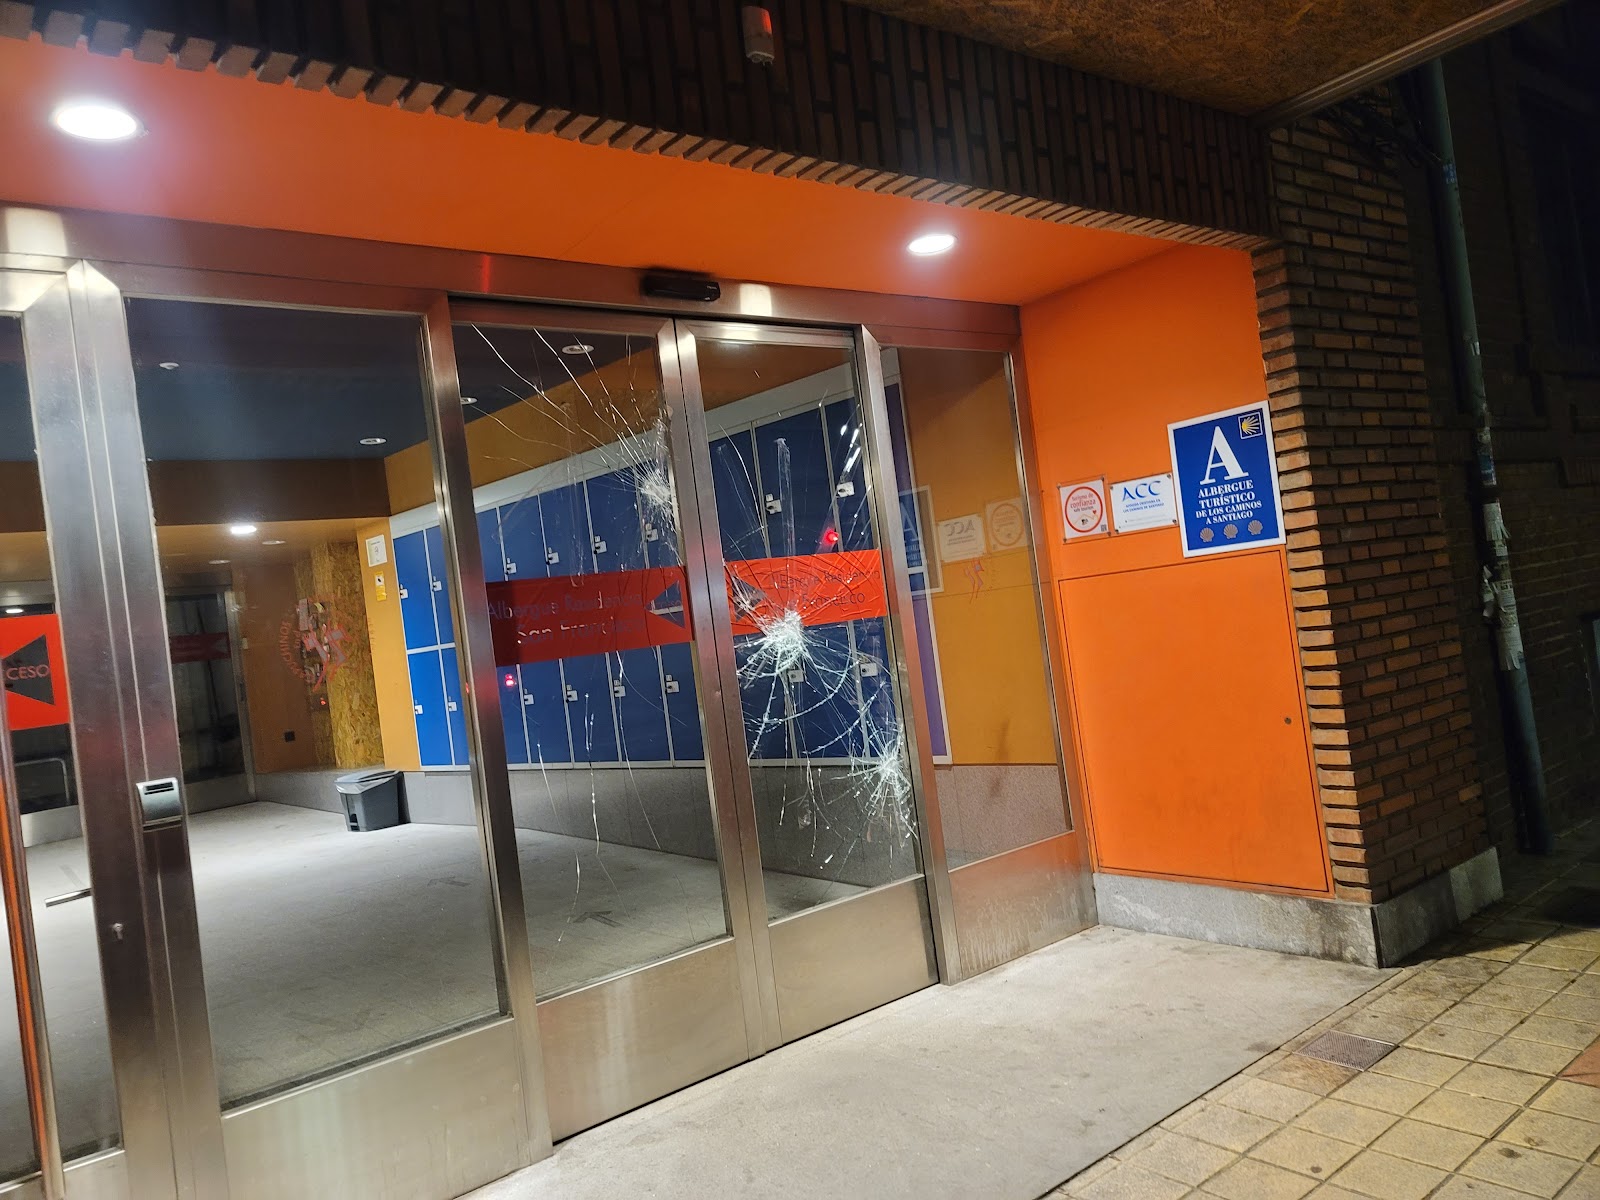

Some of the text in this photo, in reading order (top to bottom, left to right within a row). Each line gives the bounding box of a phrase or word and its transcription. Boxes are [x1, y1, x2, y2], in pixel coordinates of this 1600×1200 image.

[1199, 425, 1249, 486] A
[1122, 480, 1161, 502] ACC
[1198, 480, 1254, 498] ALBERGUE
[1195, 499, 1262, 518] DE LOS CAMINOS
[1199, 491, 1256, 509] TURÍSTICO
[1205, 510, 1254, 525] A SANTIAGO
[488, 600, 559, 620] Albergue
